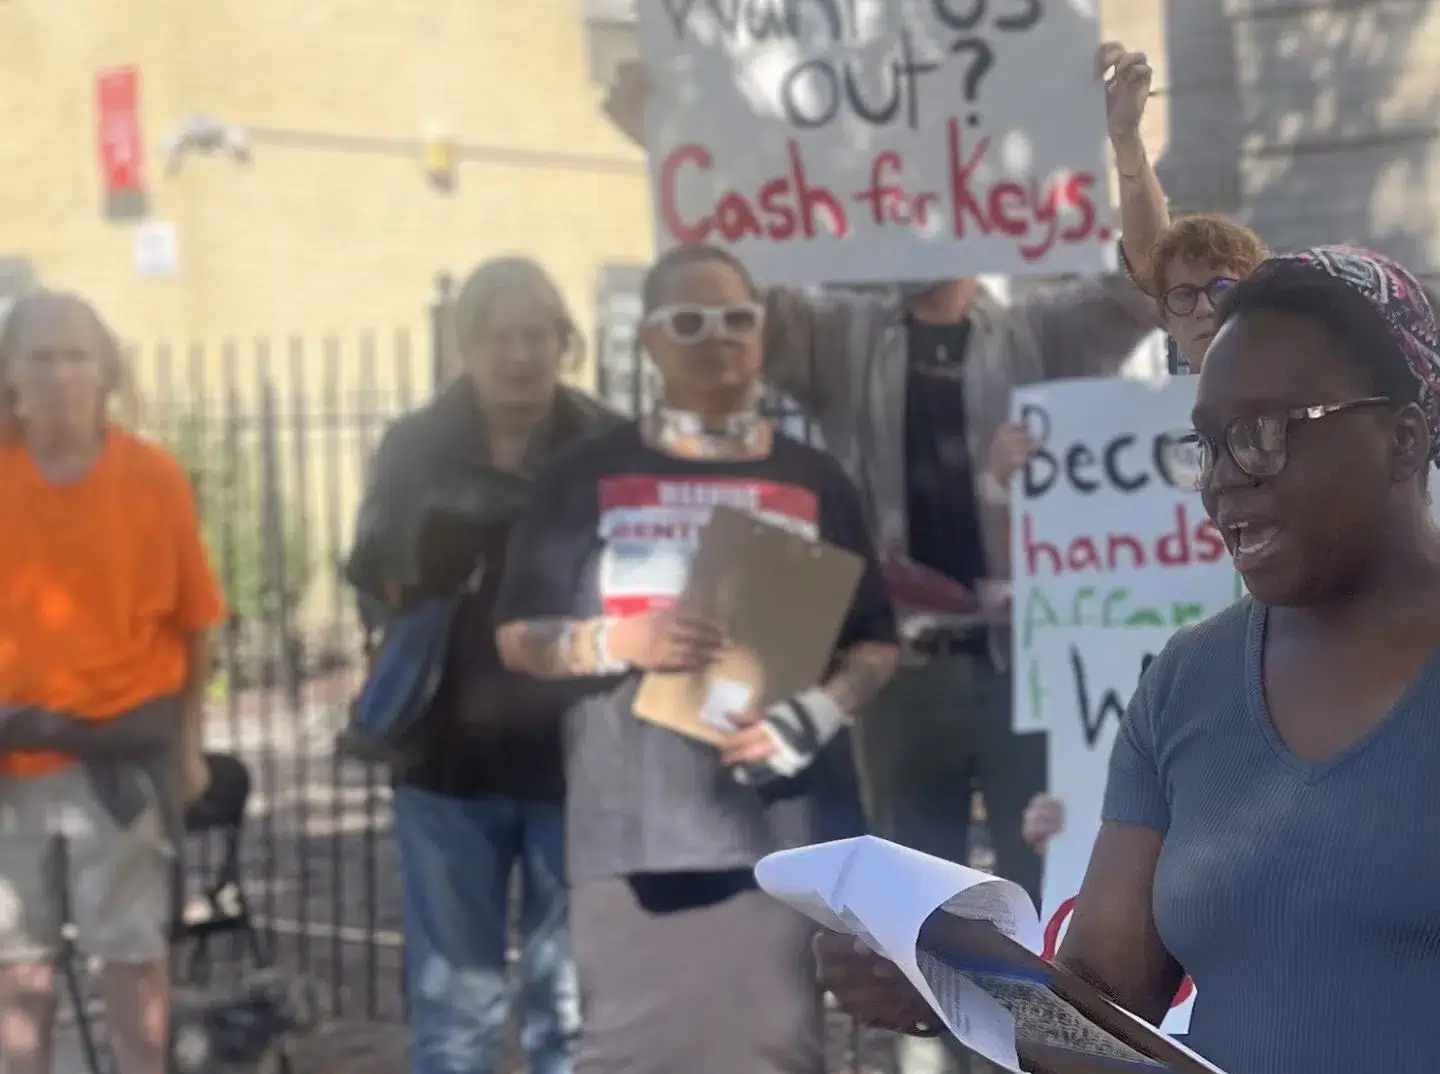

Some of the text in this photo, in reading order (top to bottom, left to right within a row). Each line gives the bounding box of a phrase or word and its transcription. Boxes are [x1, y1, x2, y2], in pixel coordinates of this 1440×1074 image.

[659, 117, 1112, 263] Cash for Keys.
[1022, 503, 1226, 577] hands
